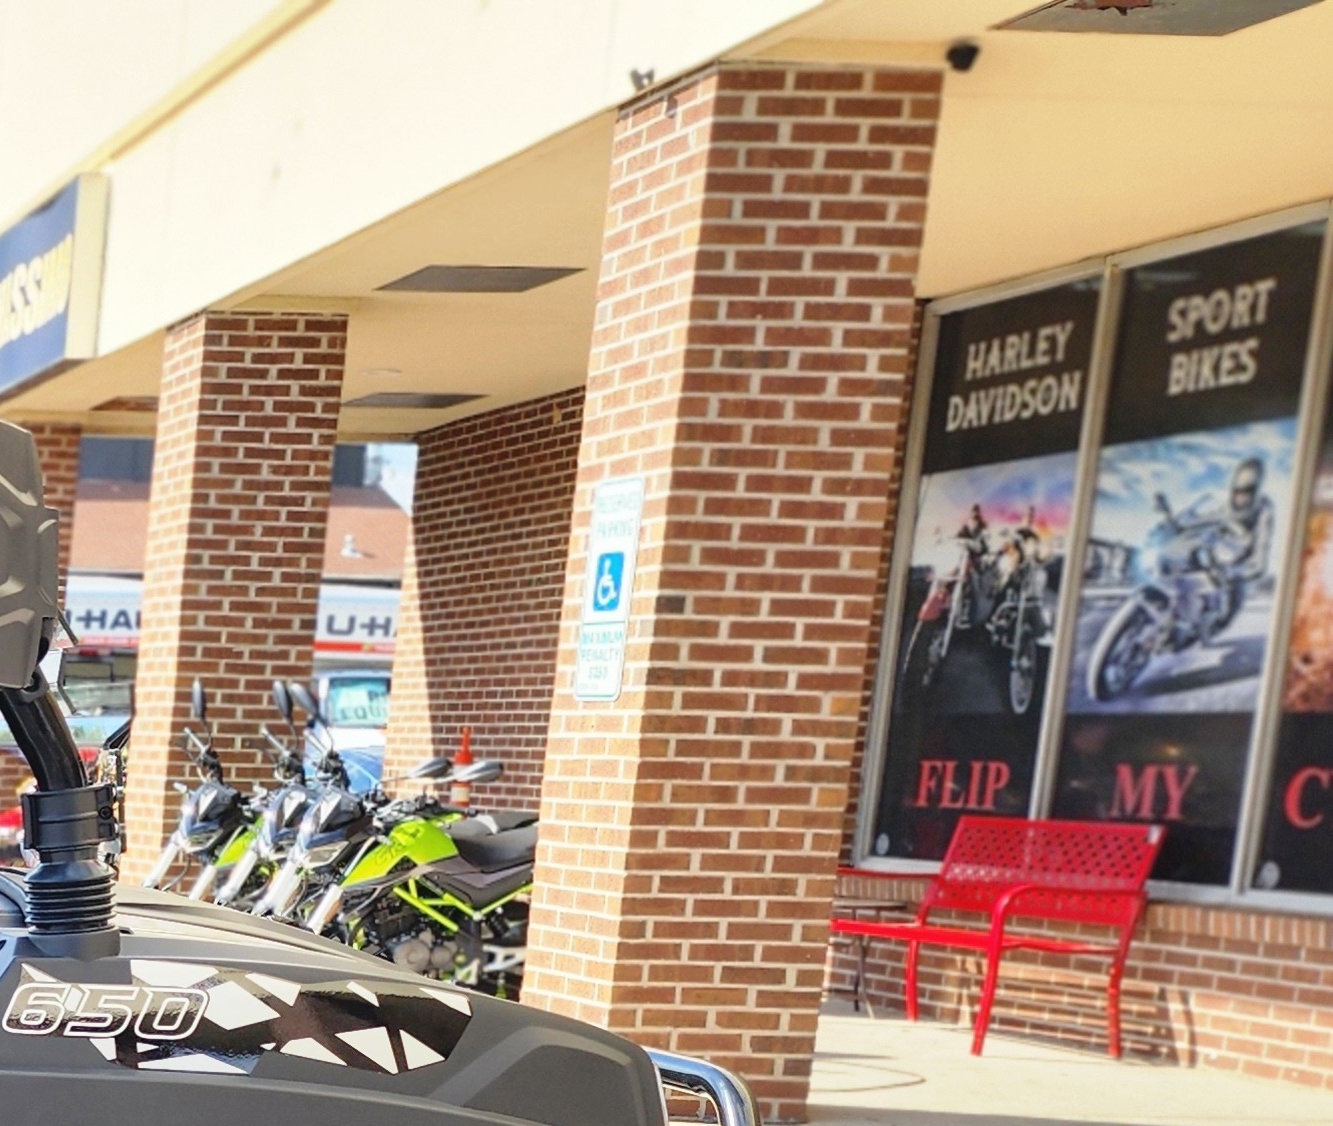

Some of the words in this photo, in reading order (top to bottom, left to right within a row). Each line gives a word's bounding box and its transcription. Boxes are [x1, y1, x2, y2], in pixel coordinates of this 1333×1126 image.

[1166, 277, 1277, 343] SPORT
[965, 320, 1074, 381] HARLEY
[1166, 337, 1262, 396] BIKES
[945, 370, 1083, 432] DAVIDSON
[915, 758, 1011, 811] FLIP
[1109, 762, 1199, 821] MY
[1, 982, 211, 1041] 650
